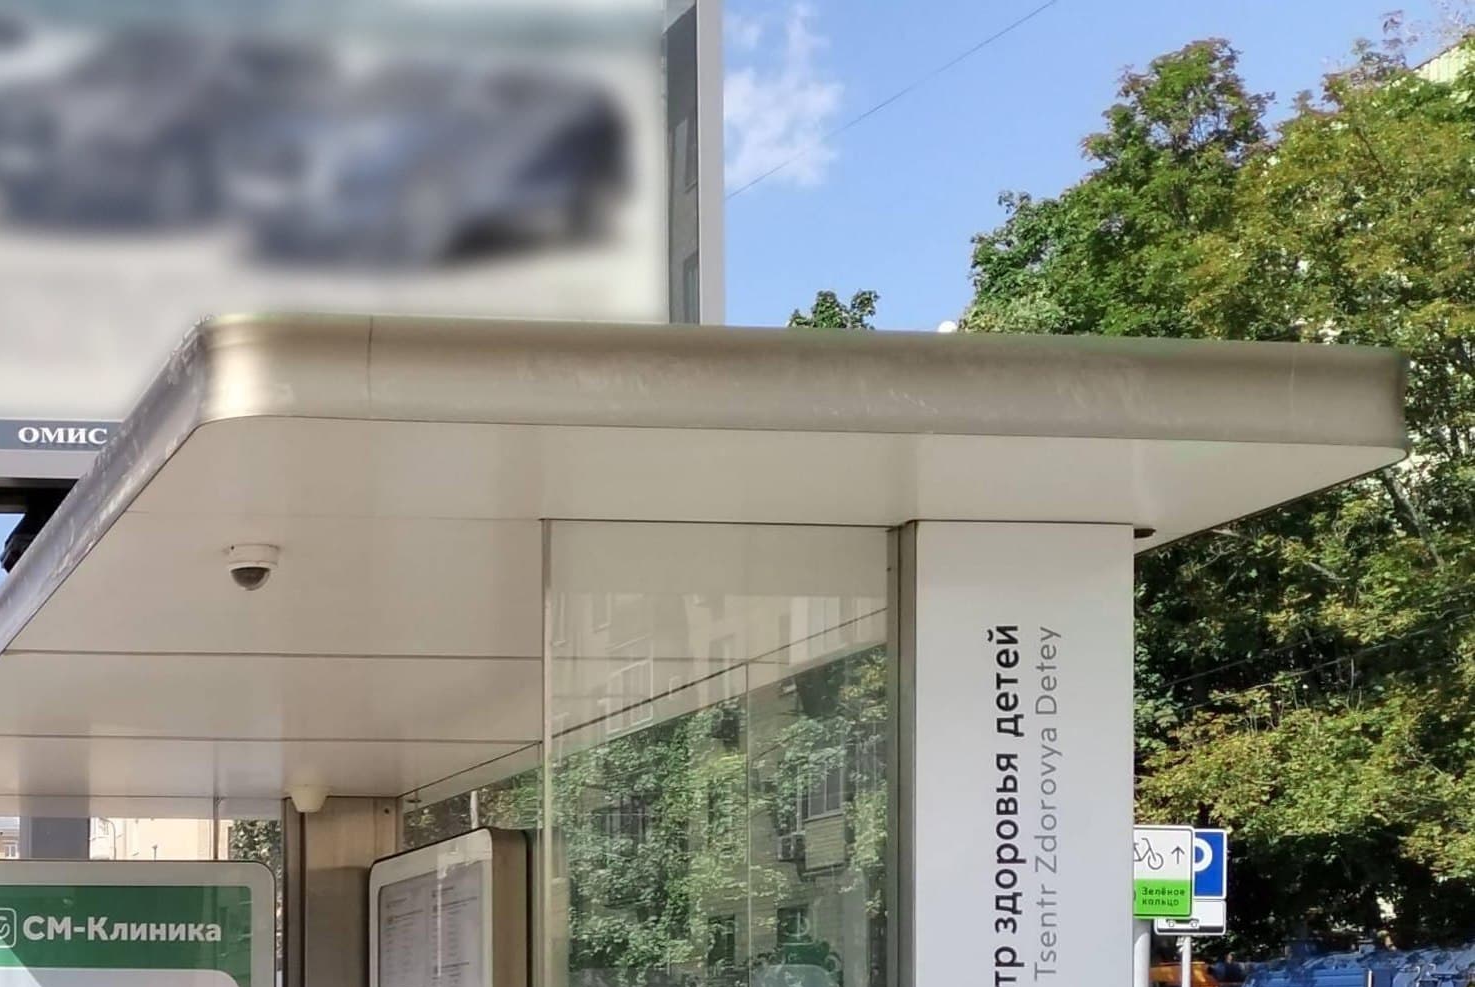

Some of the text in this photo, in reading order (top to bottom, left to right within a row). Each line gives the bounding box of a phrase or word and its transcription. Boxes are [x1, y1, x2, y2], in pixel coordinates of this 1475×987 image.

[987, 625, 1025, 738] детей
[1033, 626, 1063, 982] Tsentr Zdorovya Detey
[994, 753, 1027, 934] здоровья
[1141, 886, 1186, 896] Зелёное
[1142, 898, 1180, 907] кольцо
[23, 914, 222, 942] СМ-Клиника
